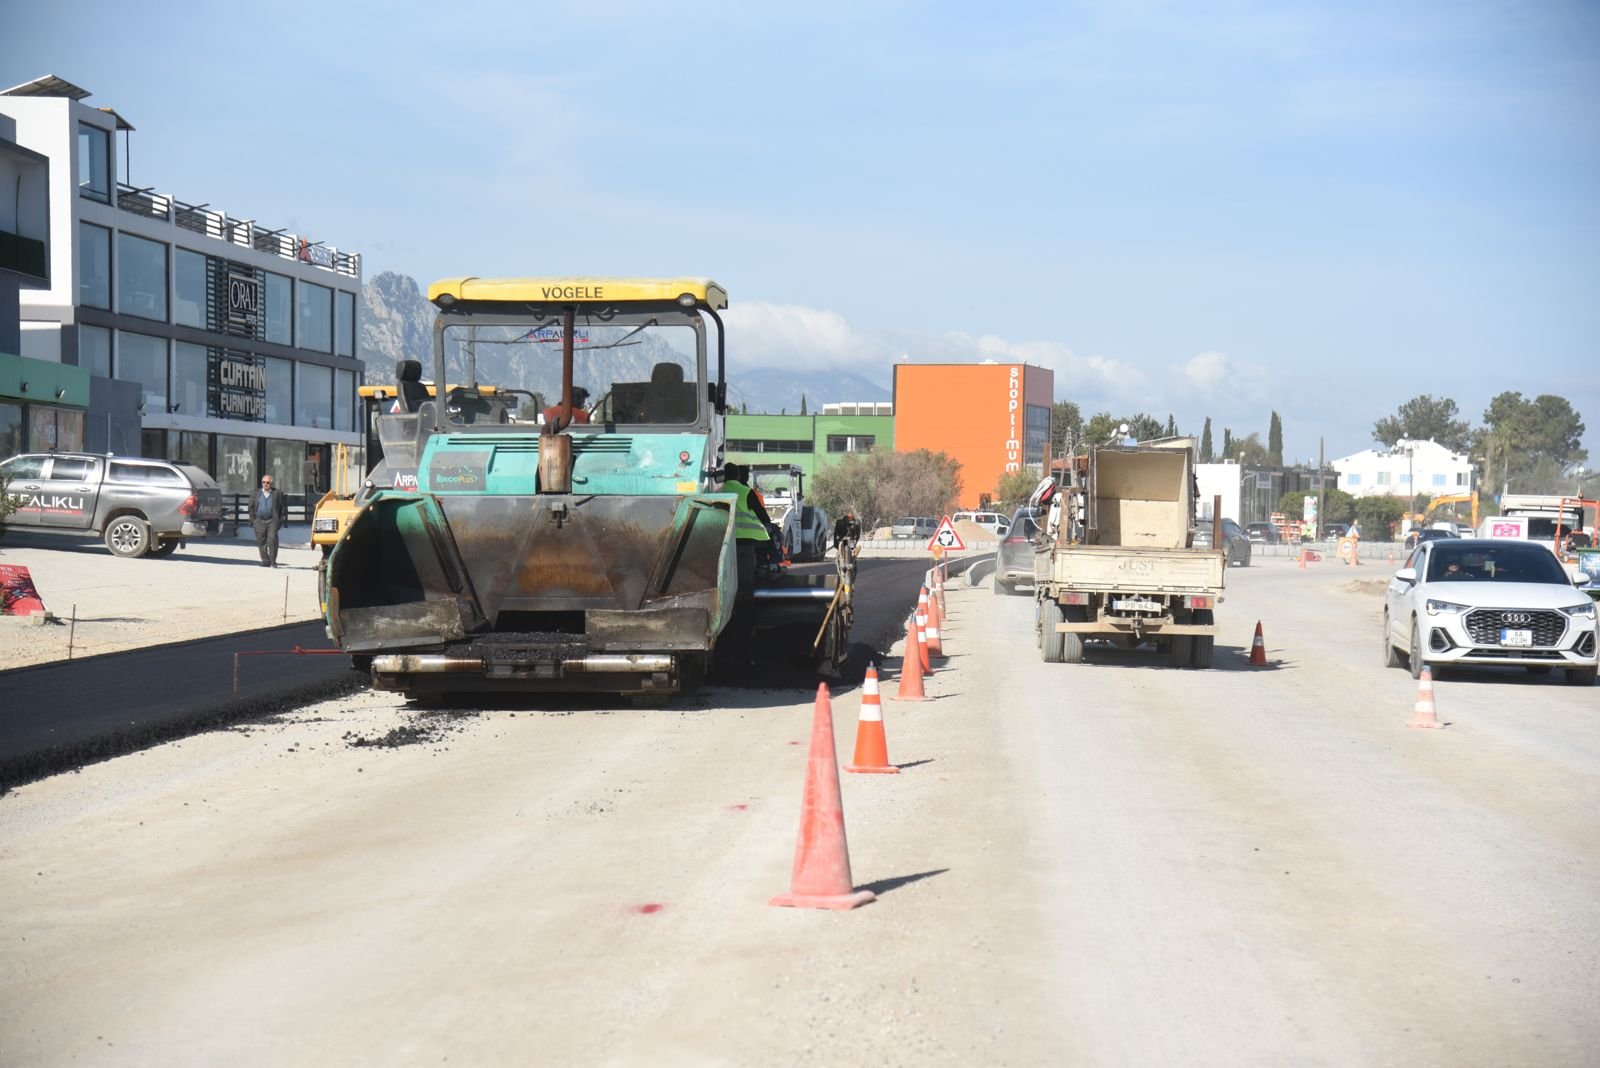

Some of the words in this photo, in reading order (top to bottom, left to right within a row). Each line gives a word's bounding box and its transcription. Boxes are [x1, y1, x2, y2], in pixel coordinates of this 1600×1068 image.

[231, 281, 257, 311] ORAL
[542, 284, 603, 298] VÖGELE
[221, 361, 265, 390] CURTAIN
[221, 394, 265, 416] FURNITURE
[1006, 368, 1019, 472] shoptimum
[1118, 559, 1158, 571] JUST
